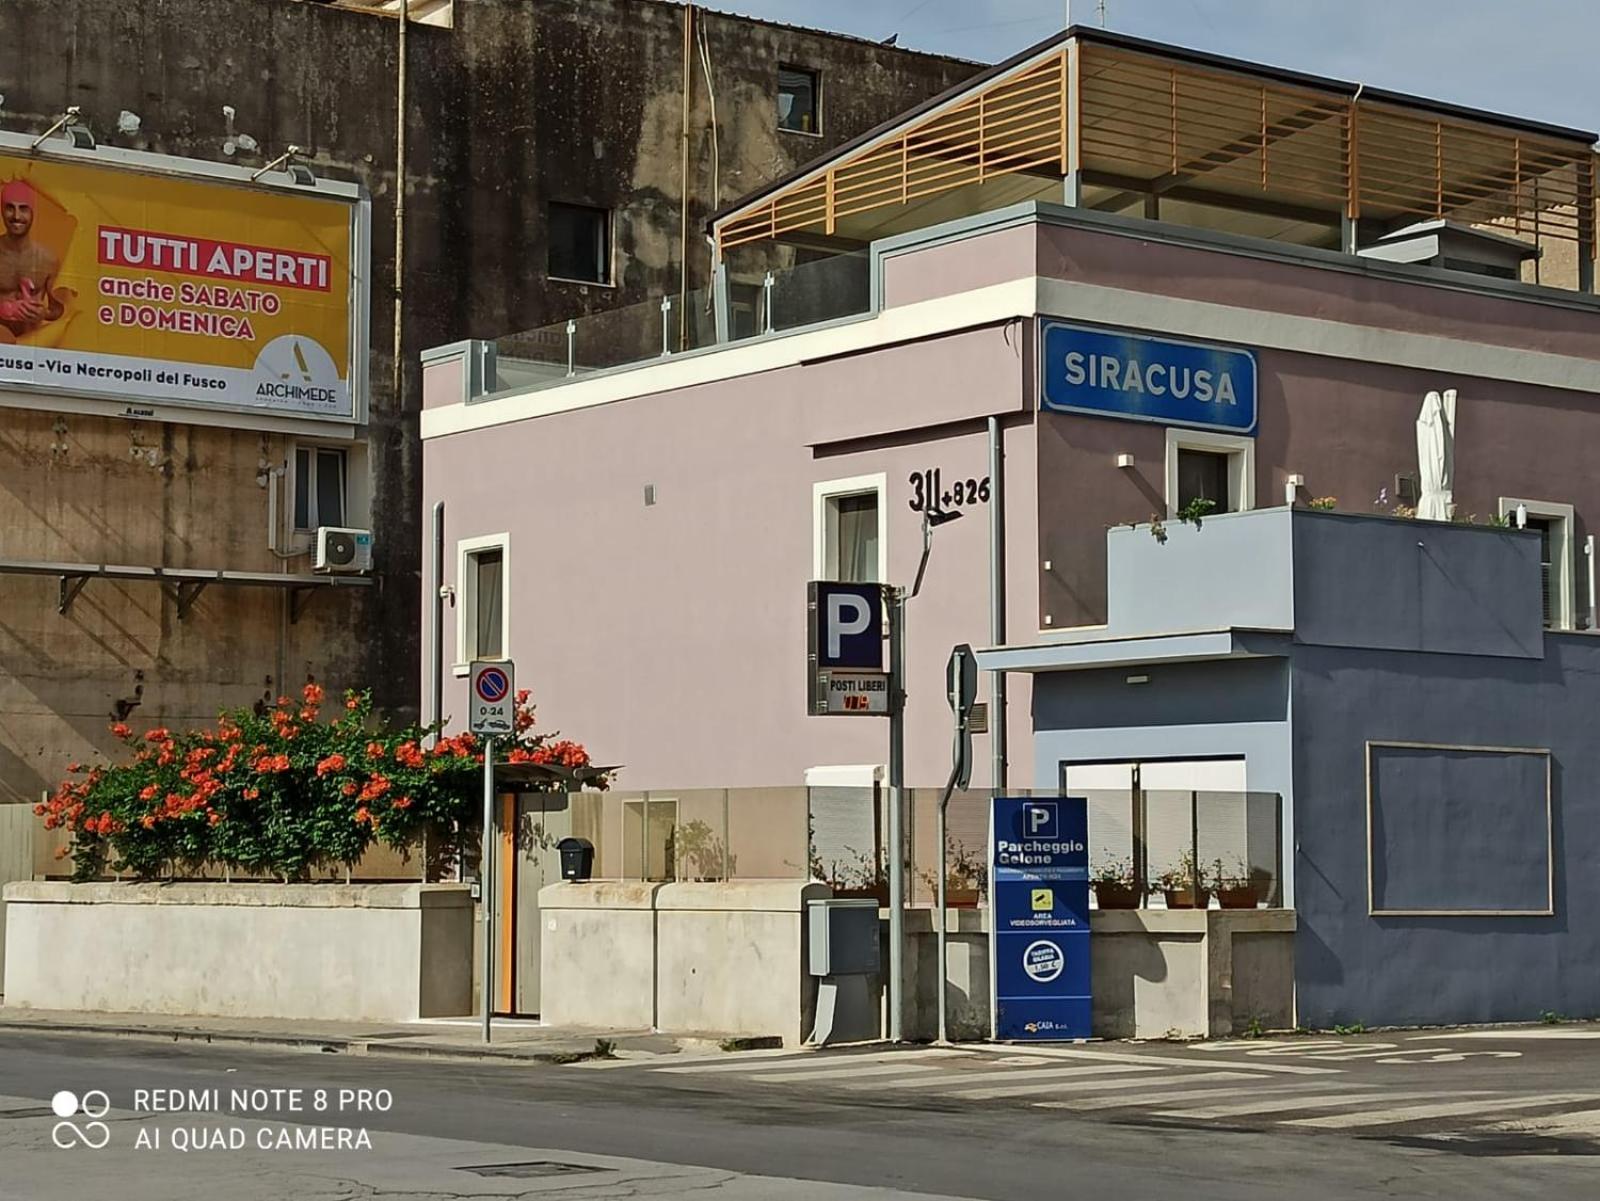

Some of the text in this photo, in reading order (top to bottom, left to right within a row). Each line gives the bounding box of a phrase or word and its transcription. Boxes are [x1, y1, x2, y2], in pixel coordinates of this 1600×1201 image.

[100, 231, 327, 287] TUTTI APERTI
[99, 277, 281, 315] anche SABATO
[99, 304, 255, 340] e DOMENICA
[77, 363, 152, 382] Necropoli
[156, 371, 179, 385] del
[183, 374, 227, 390] Fusco
[1065, 351, 1238, 405] SIRACUSA
[256, 382, 337, 403] ARCHIMEDE
[827, 593, 871, 659] P
[830, 680, 886, 691] POSTI LIBERI
[1031, 808, 1050, 833] P
[997, 840, 1084, 856] Parcheggio
[999, 853, 1052, 865] Gelone
